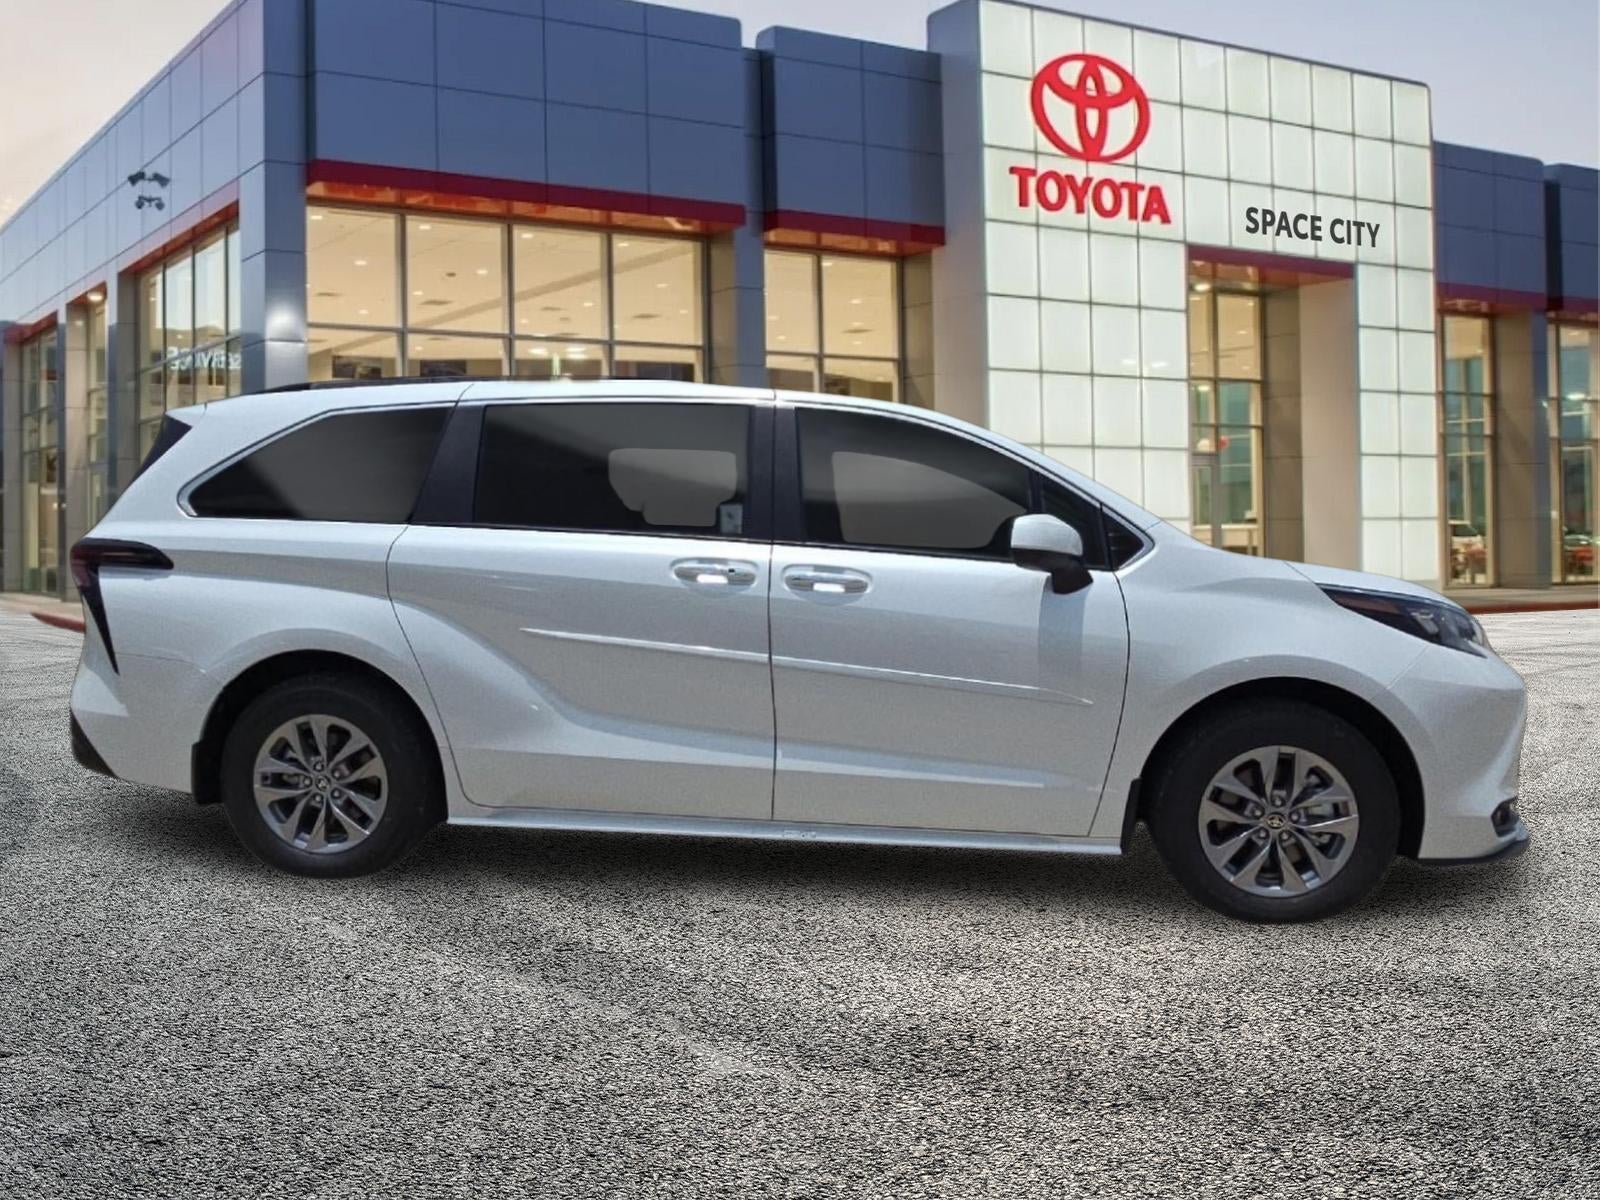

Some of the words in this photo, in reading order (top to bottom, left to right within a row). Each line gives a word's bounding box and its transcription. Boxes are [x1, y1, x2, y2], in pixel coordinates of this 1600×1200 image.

[1009, 166, 1171, 224] TOYOTA
[1245, 206, 1323, 241] SPACE
[1329, 218, 1380, 248] CITY
